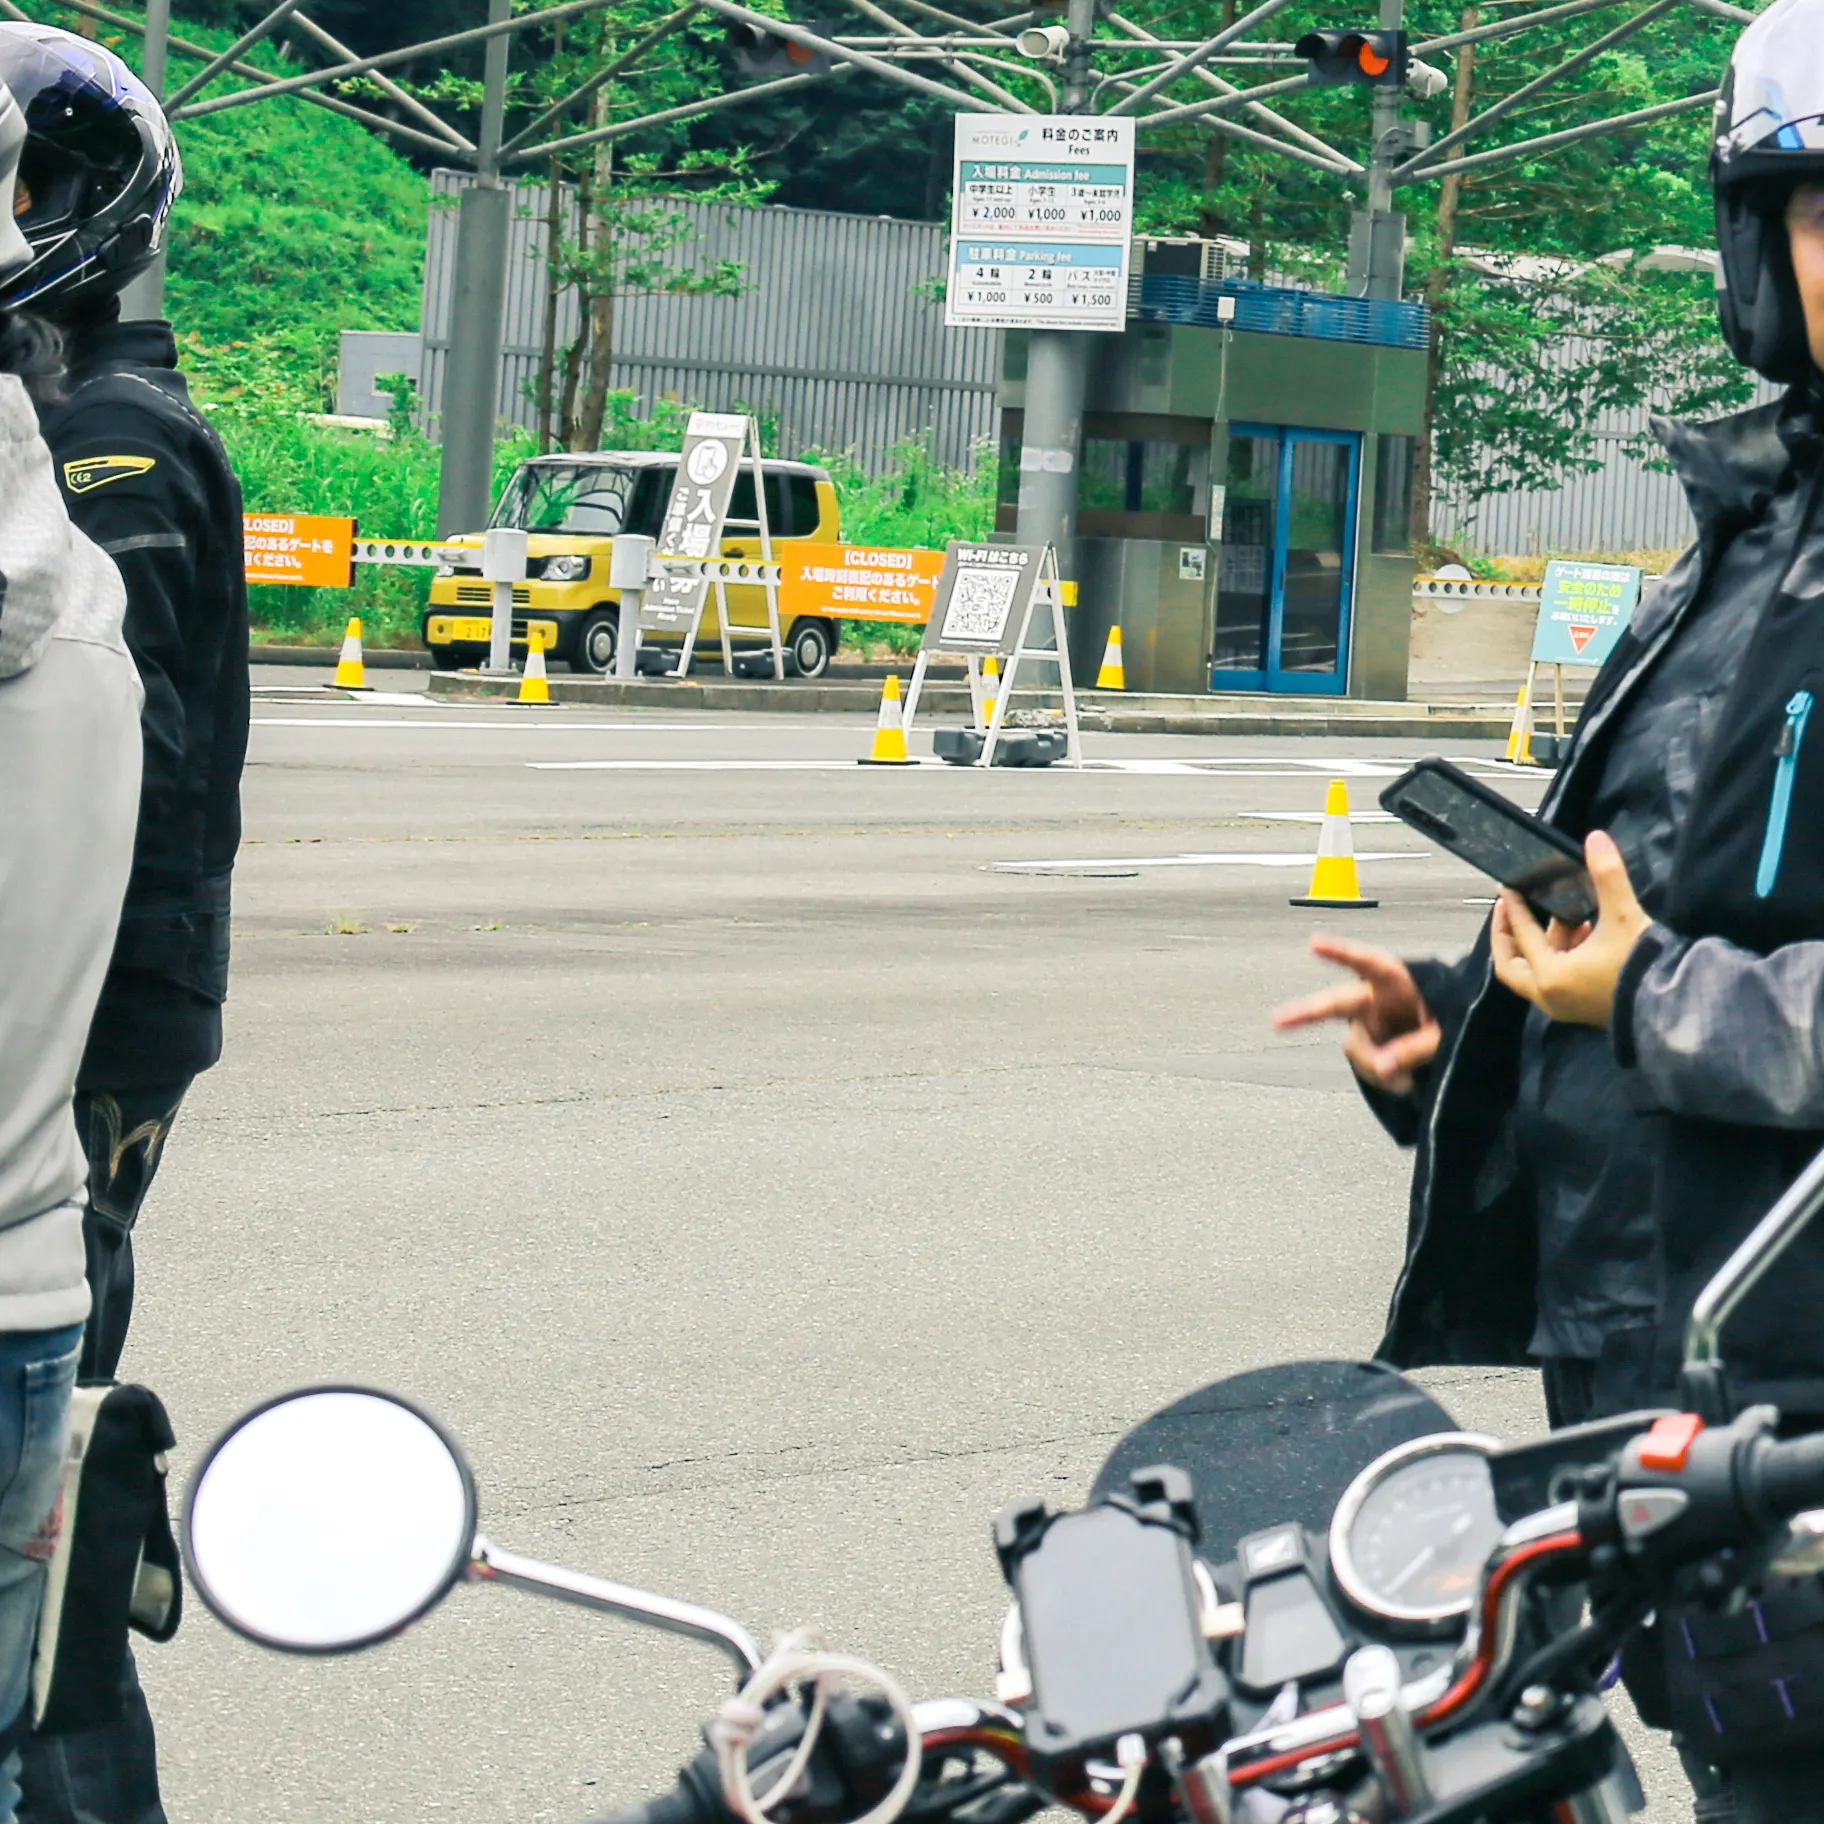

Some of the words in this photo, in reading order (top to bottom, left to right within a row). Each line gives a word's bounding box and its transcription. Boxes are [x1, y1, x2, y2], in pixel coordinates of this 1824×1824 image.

[1042, 128, 1118, 142] 料金のご案内
[1068, 145, 1090, 155] Fees
